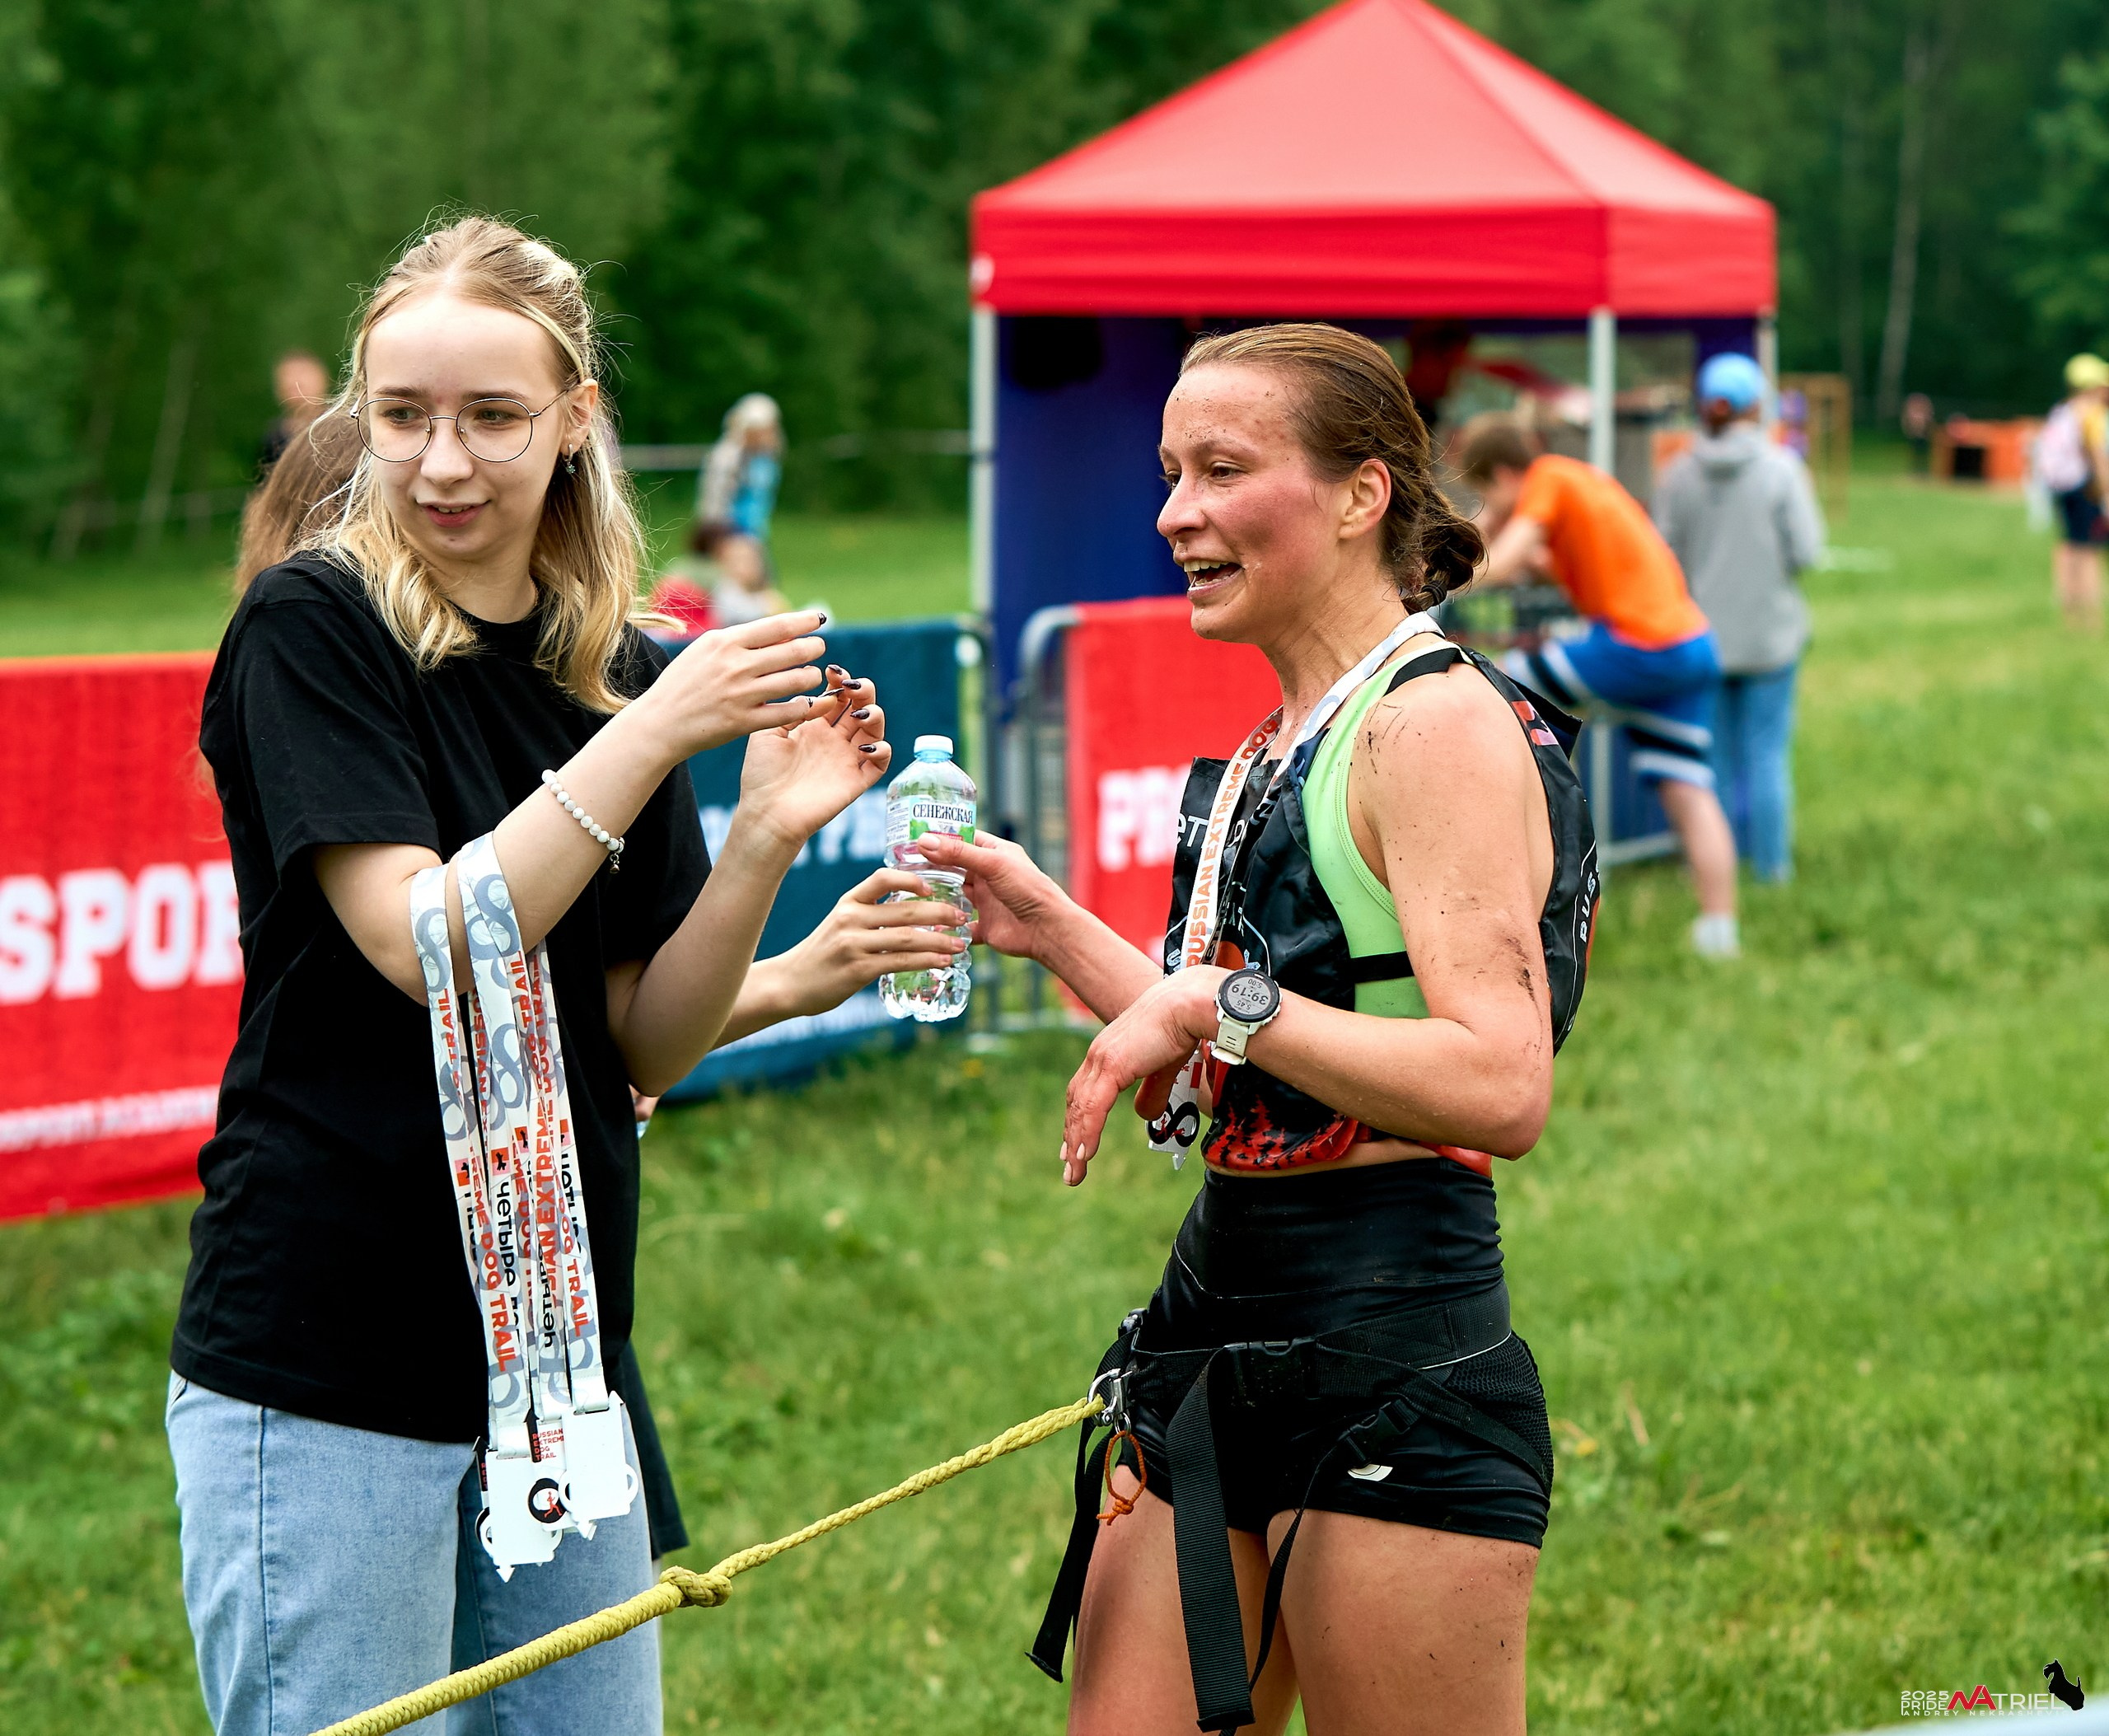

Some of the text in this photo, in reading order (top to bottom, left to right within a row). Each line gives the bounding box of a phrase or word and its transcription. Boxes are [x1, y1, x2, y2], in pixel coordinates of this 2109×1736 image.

[913, 803, 973, 825] СЕНЕЖСКАЯ
[1204, 762, 1248, 861] EXTREME
[1241, 719, 1277, 760] DOG
[509, 951, 533, 1028] TRAIL
[1231, 984, 1269, 1005] 39:19
[437, 988, 459, 1065] TRAIL
[480, 1232, 503, 1291] DOG
[566, 1259, 589, 1337] TRAIL
[489, 1294, 517, 1373] TRAIL
[532, 1428, 563, 1440] RUSSIAN
[534, 1446, 550, 1454] DOG
[535, 1453, 557, 1461] TRAIL
